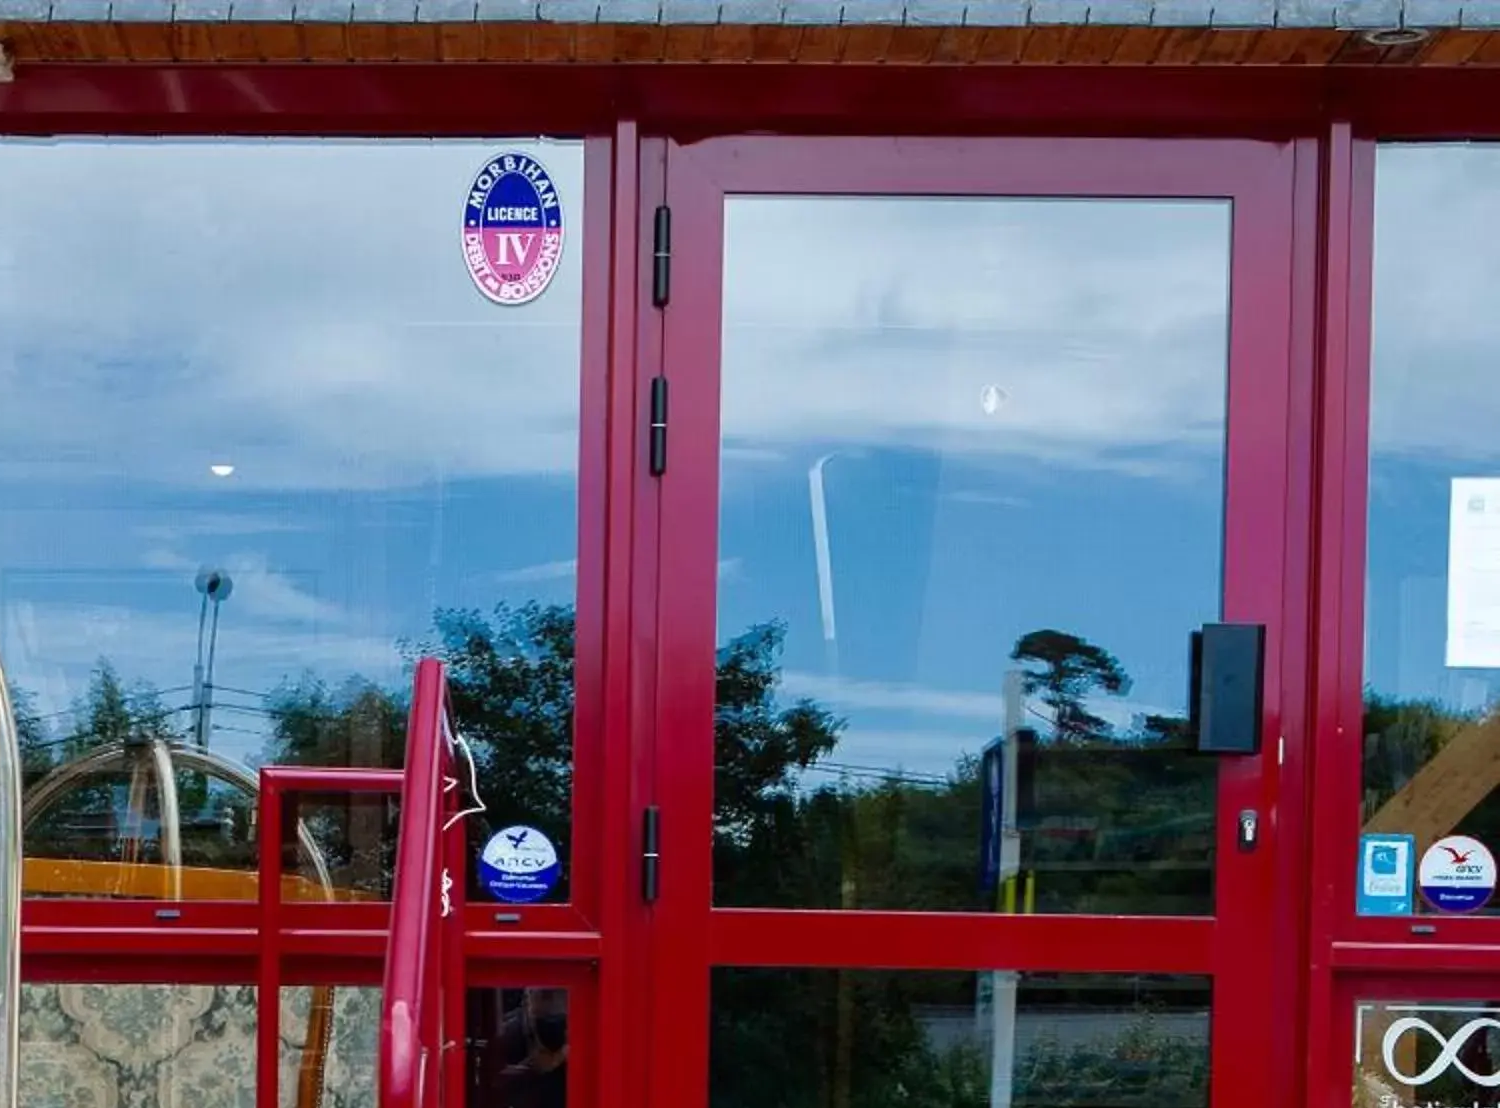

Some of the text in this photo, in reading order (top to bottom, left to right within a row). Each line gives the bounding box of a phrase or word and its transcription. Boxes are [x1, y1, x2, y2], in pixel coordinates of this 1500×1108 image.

[469, 155, 558, 208] MORBIHAN
[487, 207, 539, 221] LICENCE
[465, 233, 559, 298] DEBIT BOISSONS
[495, 233, 537, 266] IV
